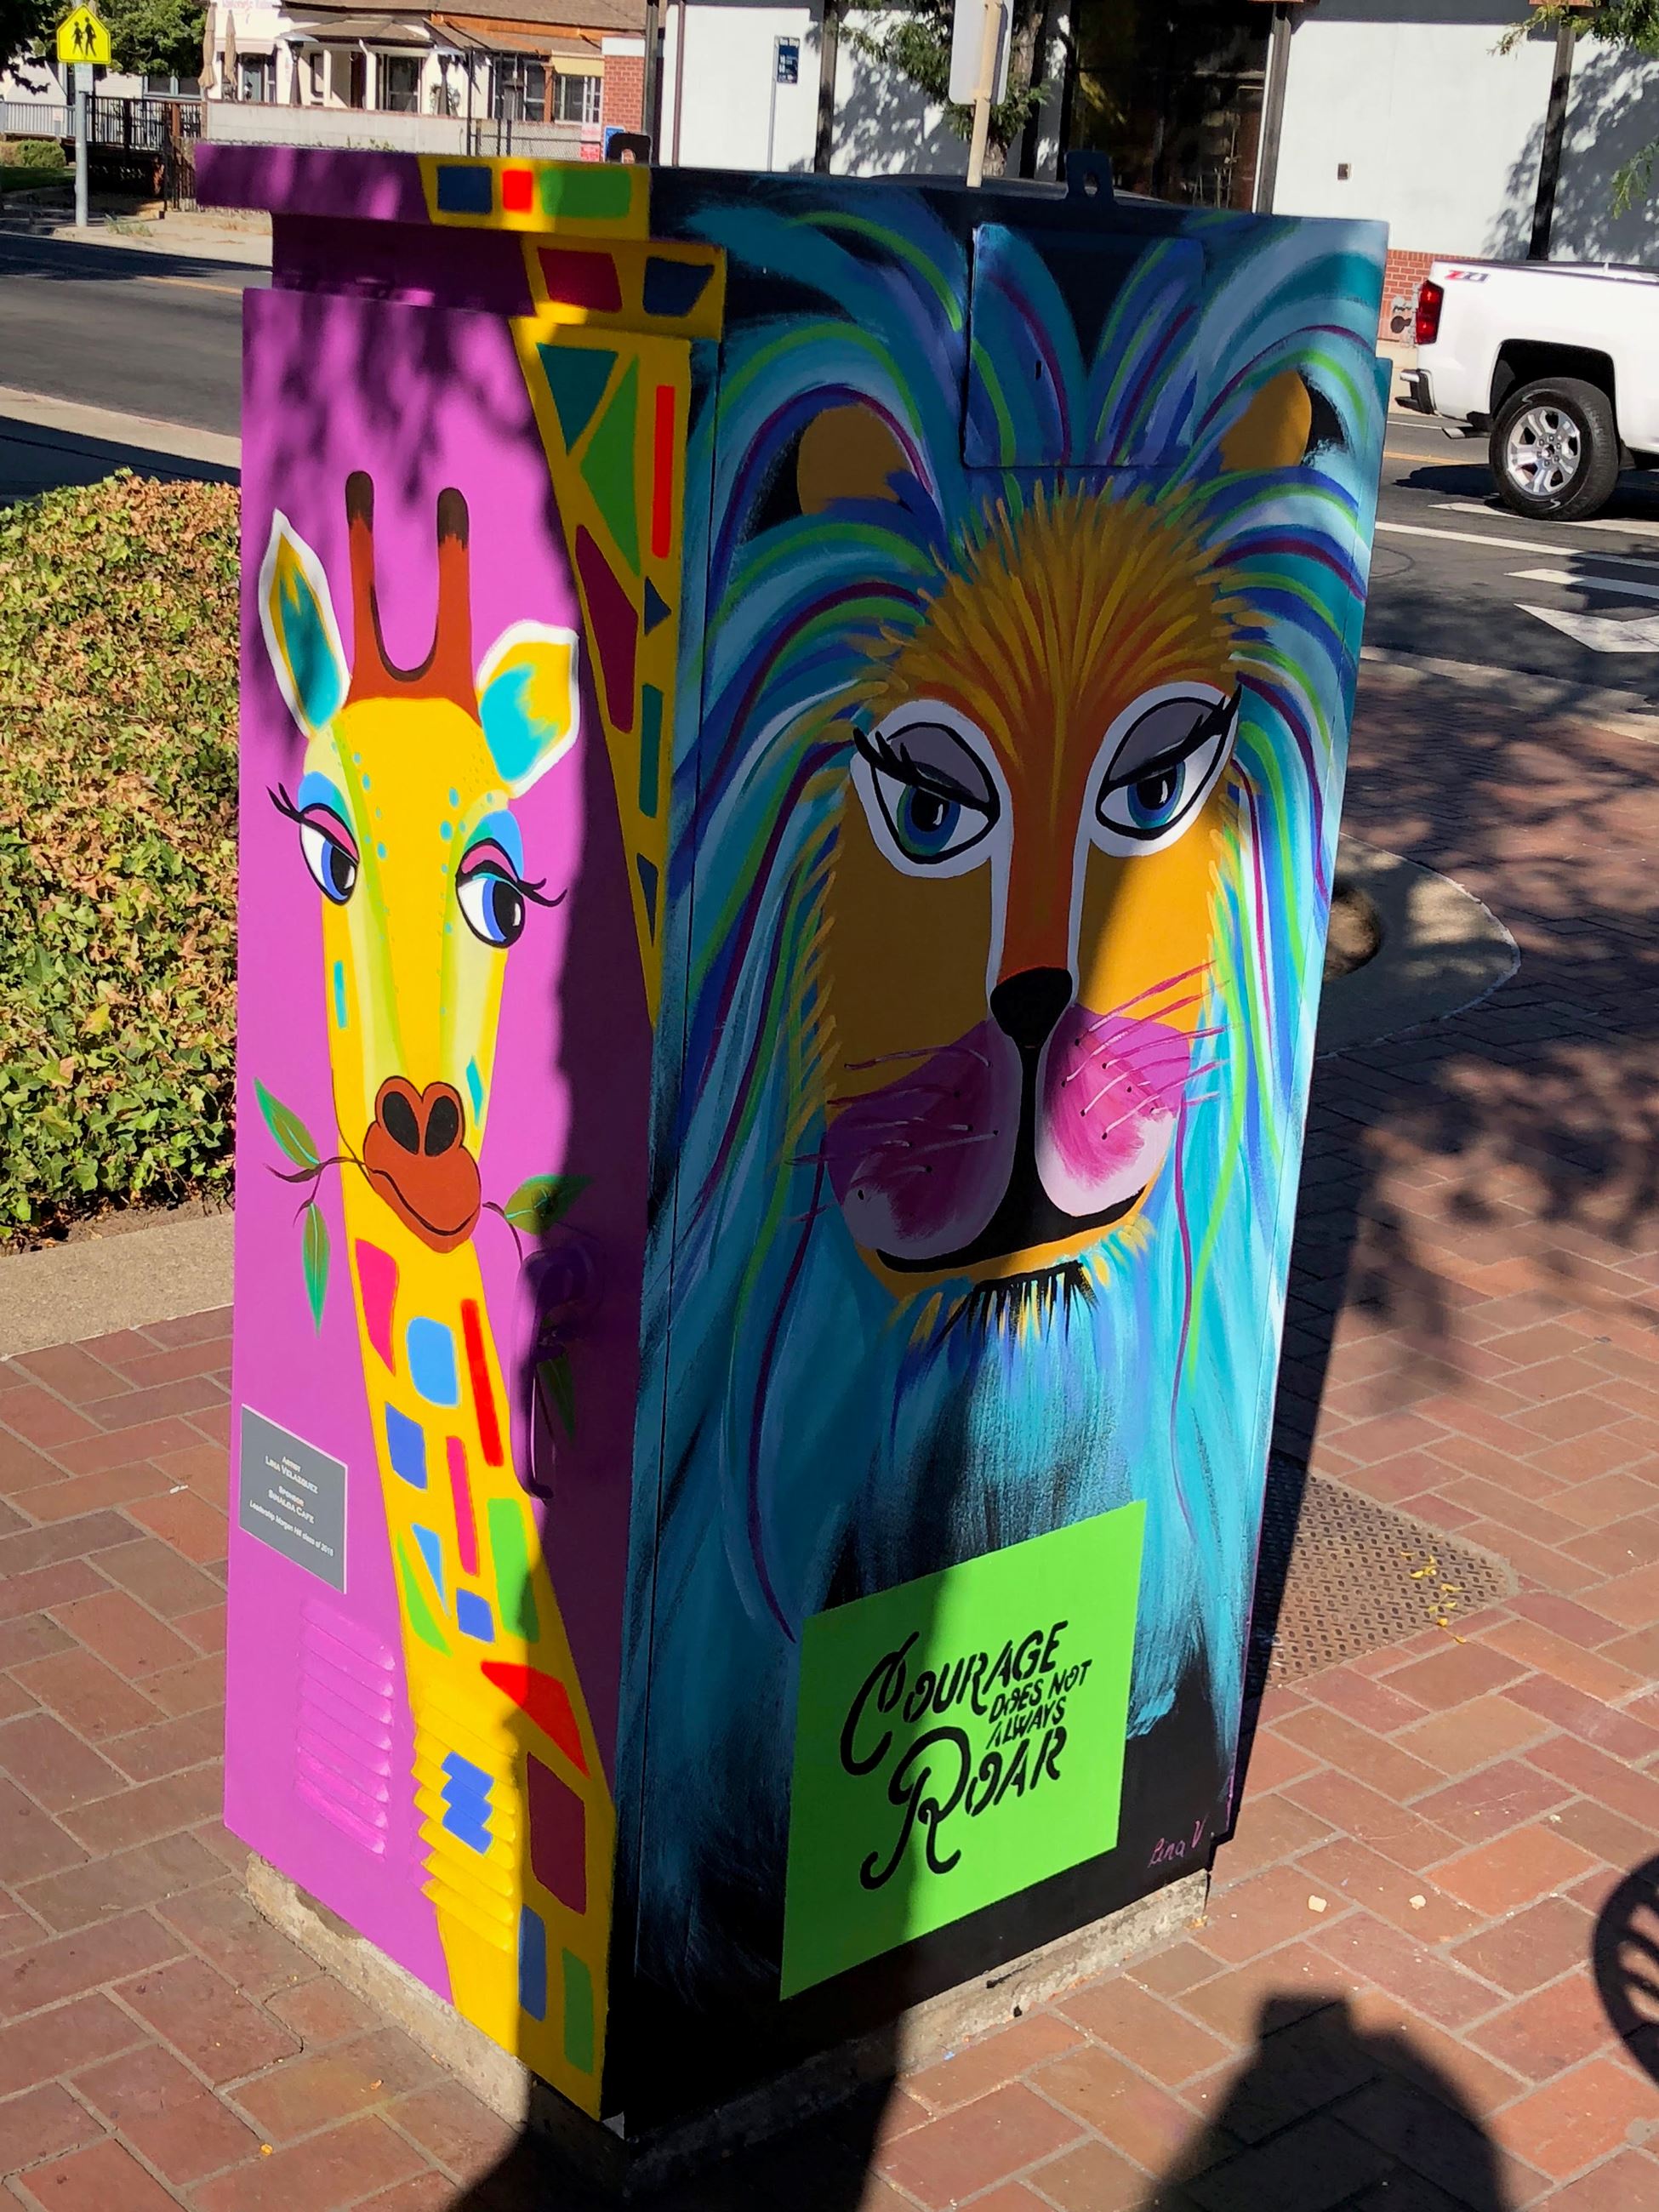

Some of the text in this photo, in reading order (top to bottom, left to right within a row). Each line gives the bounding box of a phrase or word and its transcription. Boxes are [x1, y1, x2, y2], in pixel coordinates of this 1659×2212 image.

[840, 1620, 1069, 1776] COURAGE
[985, 1696, 1067, 1750] ALWAYS
[988, 1659, 1093, 1724] DOES NOT
[859, 1725, 1068, 1890] ROAR
